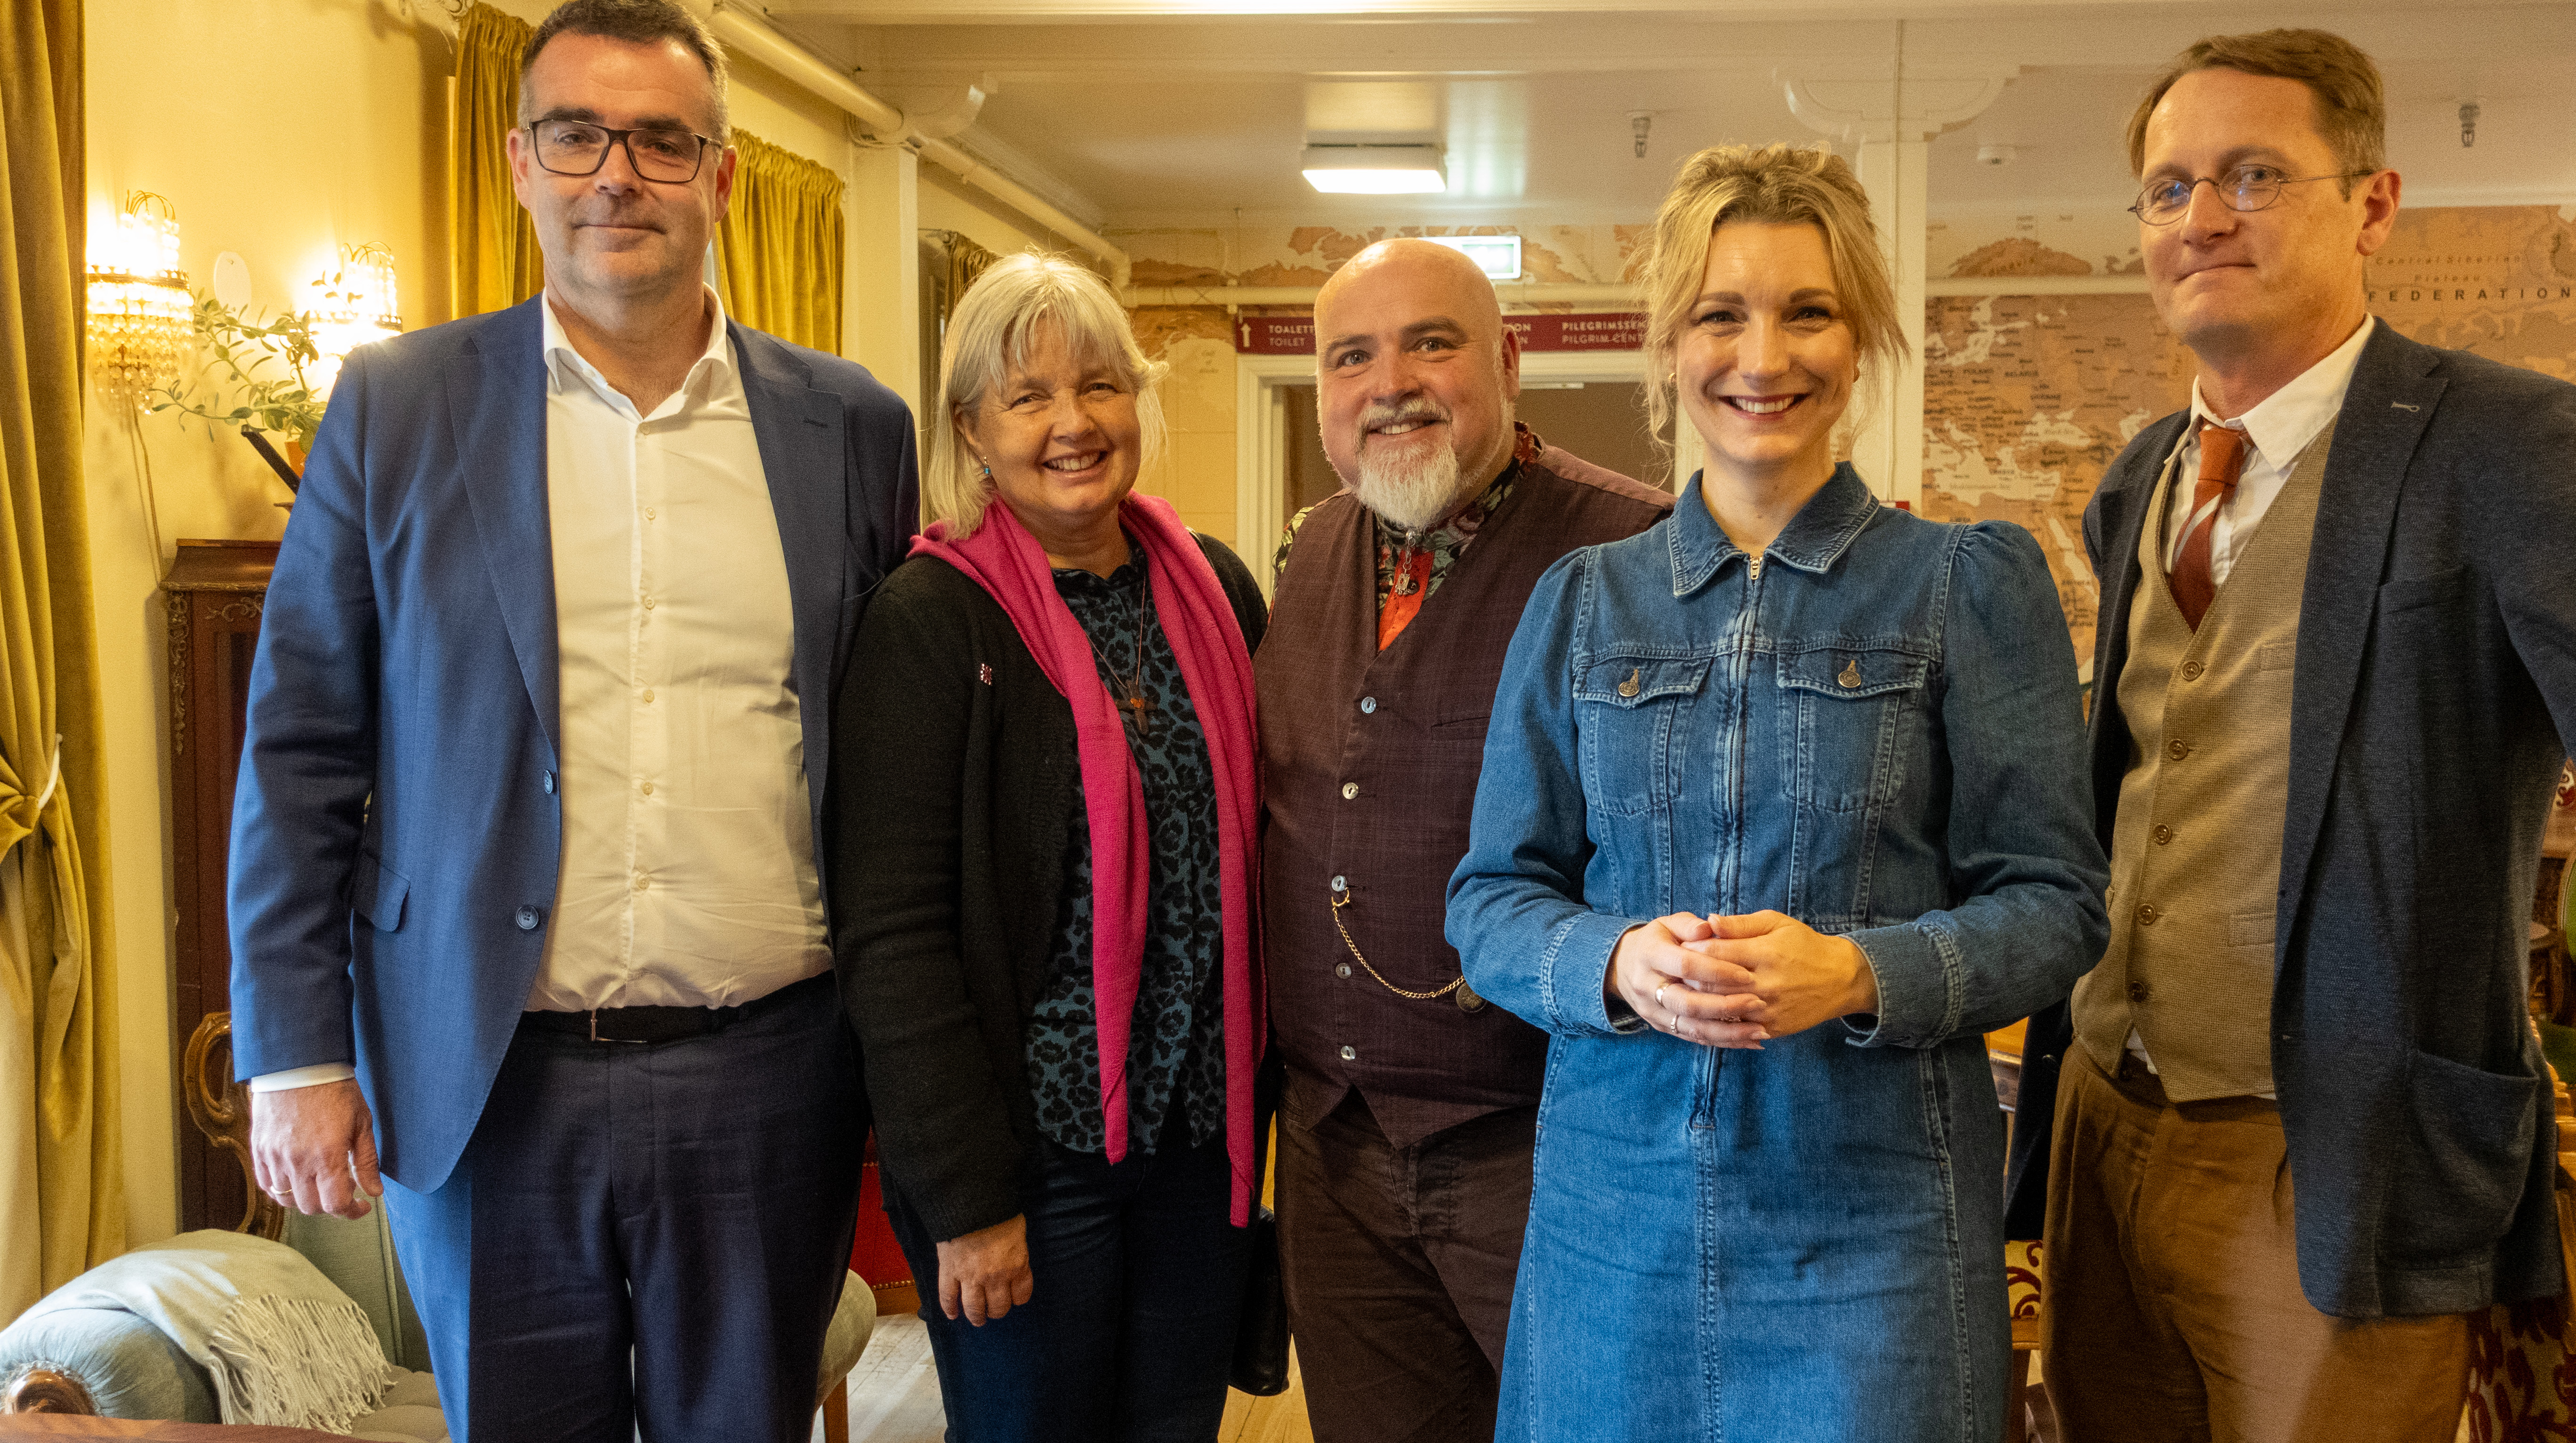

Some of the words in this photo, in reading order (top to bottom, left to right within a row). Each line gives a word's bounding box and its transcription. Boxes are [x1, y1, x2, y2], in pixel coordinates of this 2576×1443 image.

[2368, 287, 2571, 302] FEDERATION
[1269, 337, 1305, 346] TOILET
[1562, 334, 1609, 345] PILGRIM
